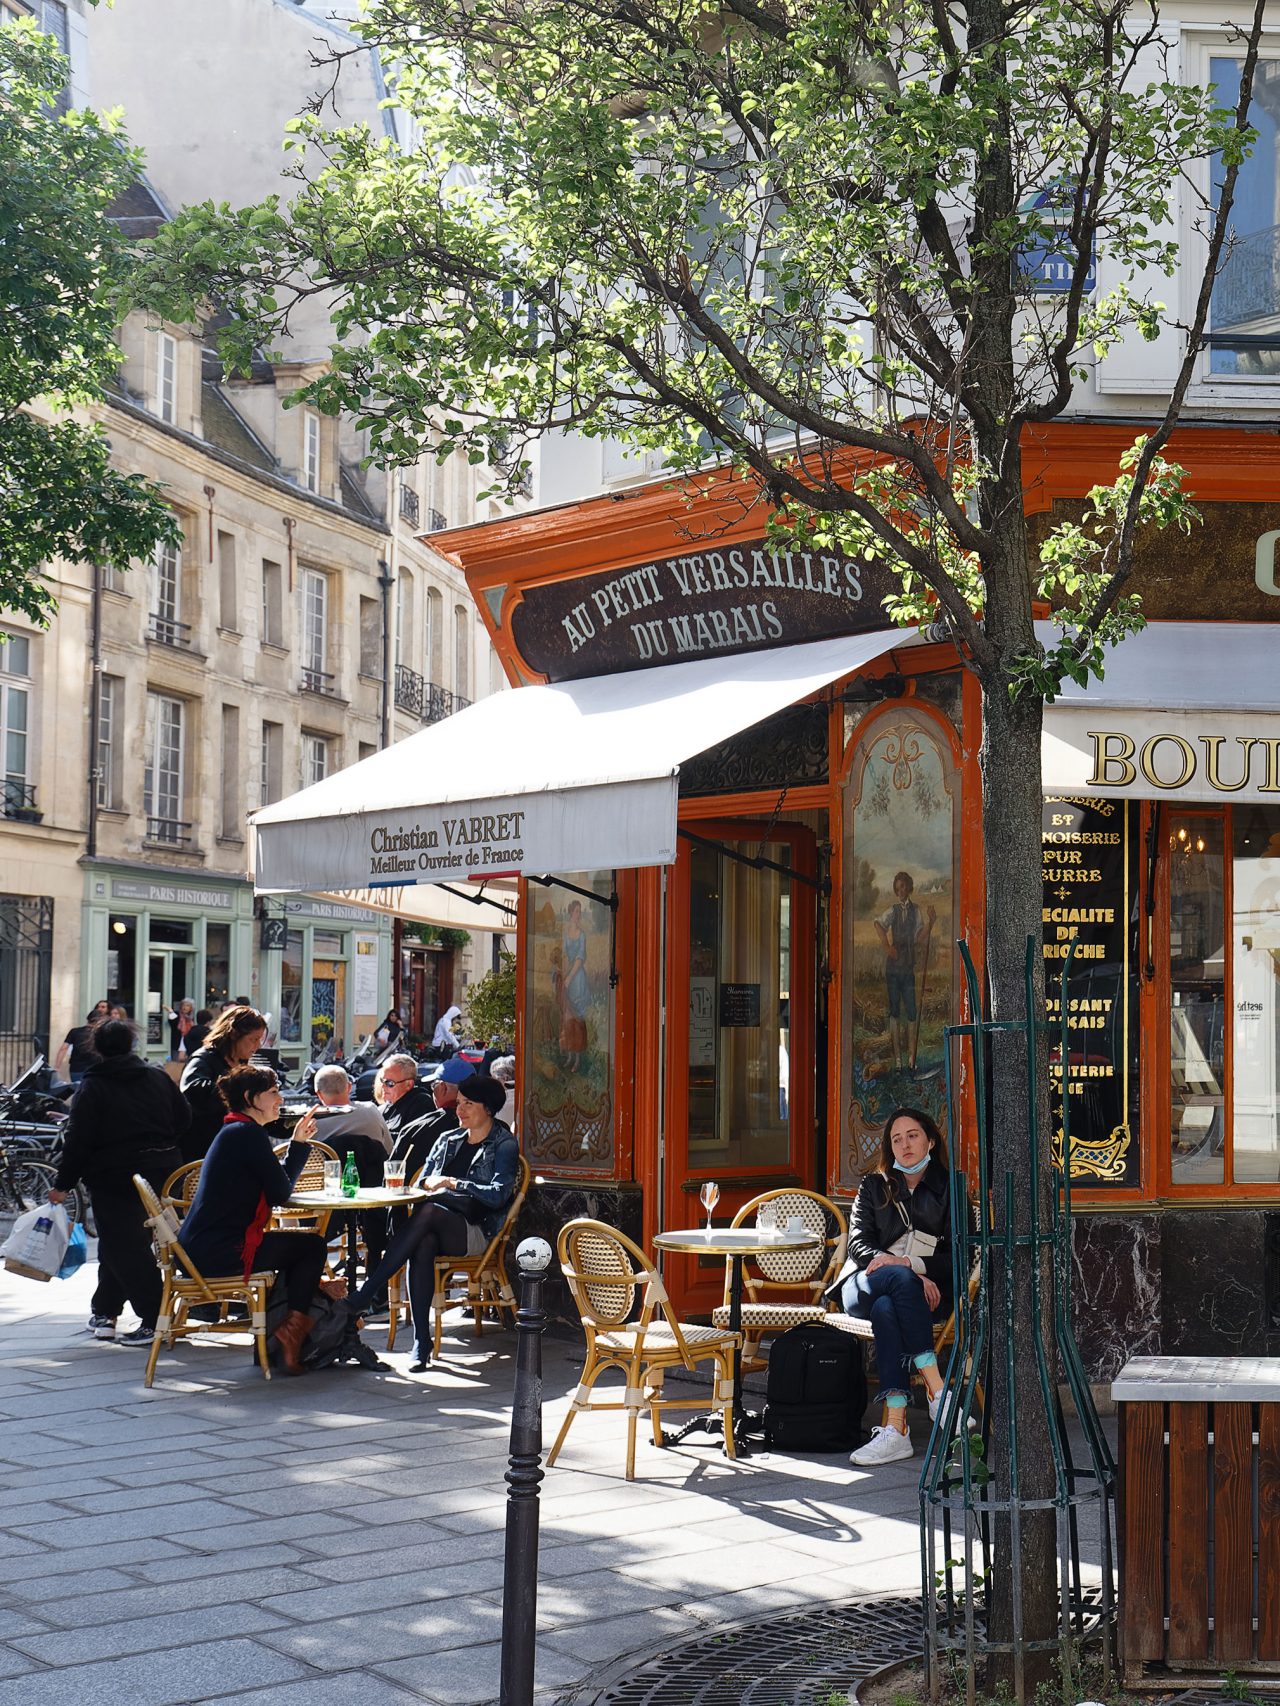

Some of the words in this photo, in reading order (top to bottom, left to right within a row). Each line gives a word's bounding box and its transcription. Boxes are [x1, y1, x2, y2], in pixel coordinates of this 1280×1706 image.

[561, 602, 596, 653] AU
[591, 564, 664, 627] PETIT
[667, 549, 864, 602] VERSAILLES
[630, 619, 669, 660] DU
[668, 601, 783, 654] MARAIS
[1052, 814, 1074, 826] ET
[371, 825, 439, 854] Christian
[442, 812, 525, 847] VABRET
[370, 856, 417, 874] Meilleur
[418, 851, 463, 870] Ouvrier
[465, 847, 480, 866] de
[482, 846, 524, 864] France
[1043, 850, 1082, 864] PUR
[149, 886, 175, 901] PARIS
[177, 889, 230, 908] HISTORIQUE
[312, 903, 331, 916] PARIS
[332, 905, 374, 921] HISTORIQUE
[1042, 908, 1114, 923] ECIALITE
[1046, 999, 1112, 1011] OISANT
